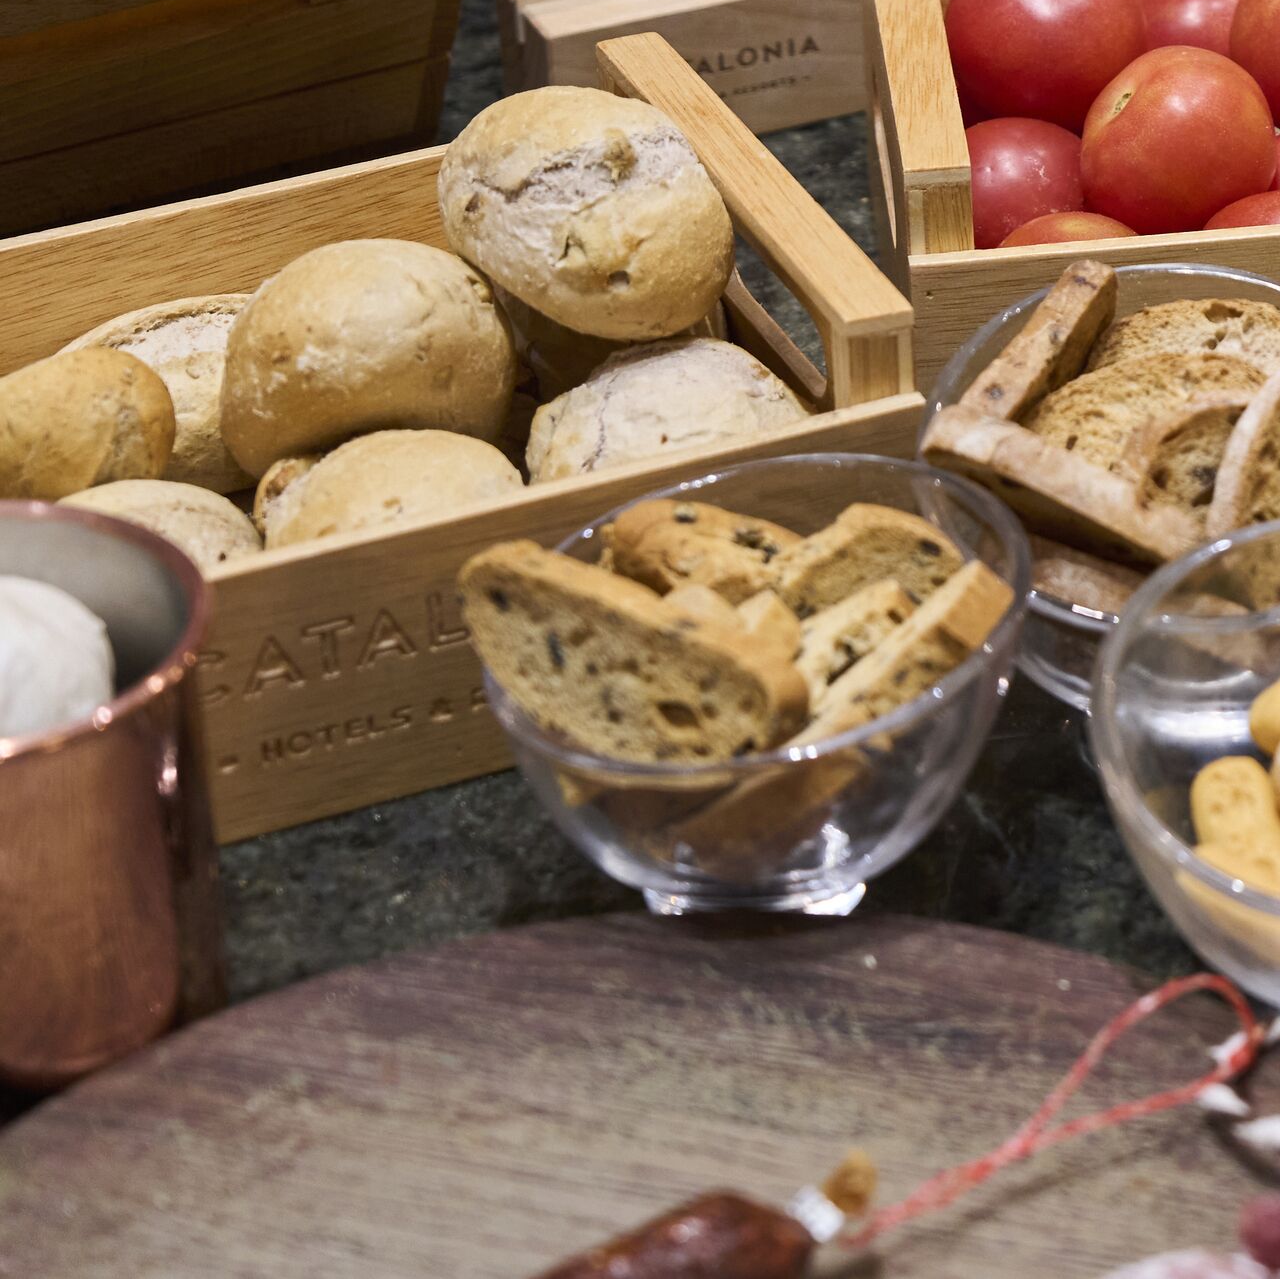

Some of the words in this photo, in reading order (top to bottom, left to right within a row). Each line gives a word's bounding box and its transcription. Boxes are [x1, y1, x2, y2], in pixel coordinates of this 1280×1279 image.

[686, 34, 820, 75] ALONIA
[197, 592, 473, 708] CATAL
[260, 704, 412, 768] HOTELS
